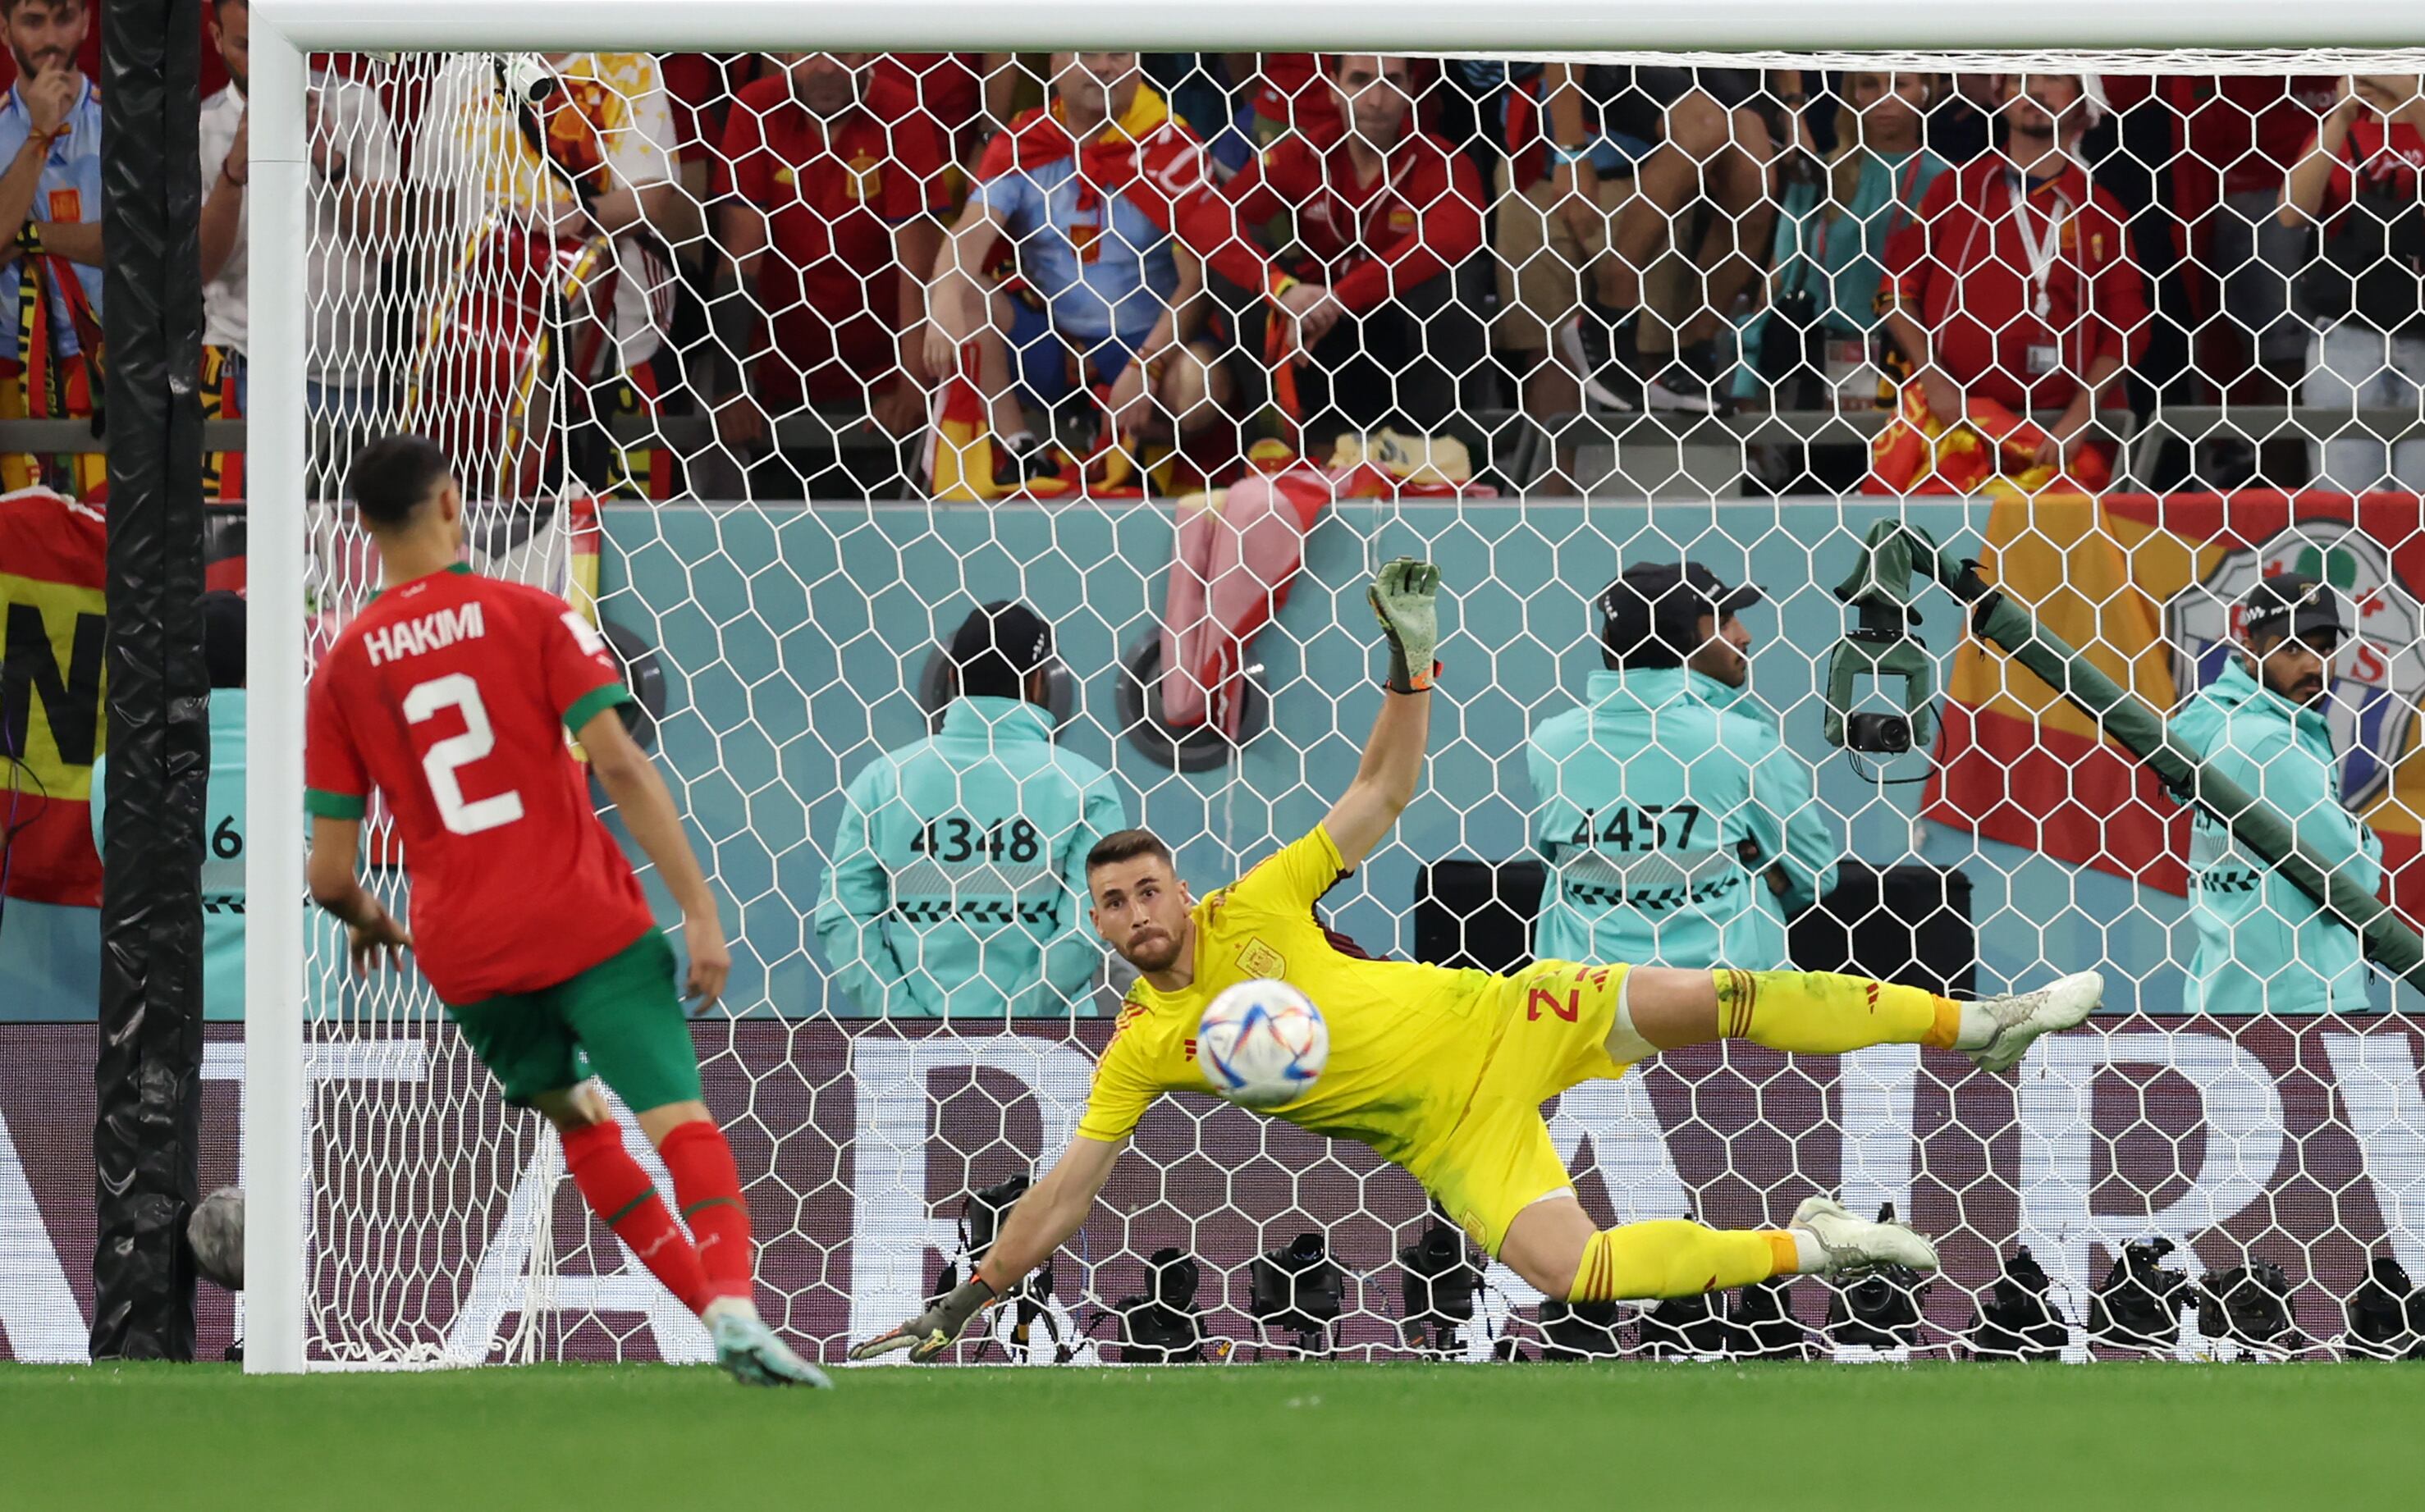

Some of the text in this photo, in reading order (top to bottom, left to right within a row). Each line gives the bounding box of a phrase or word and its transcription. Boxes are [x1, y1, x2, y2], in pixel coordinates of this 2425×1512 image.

[364, 601, 484, 667] HAKIMI
[2350, 642, 2389, 683] S
[402, 672, 525, 835] 2
[910, 818, 1038, 862] 4348
[1572, 805, 1700, 852] 4457
